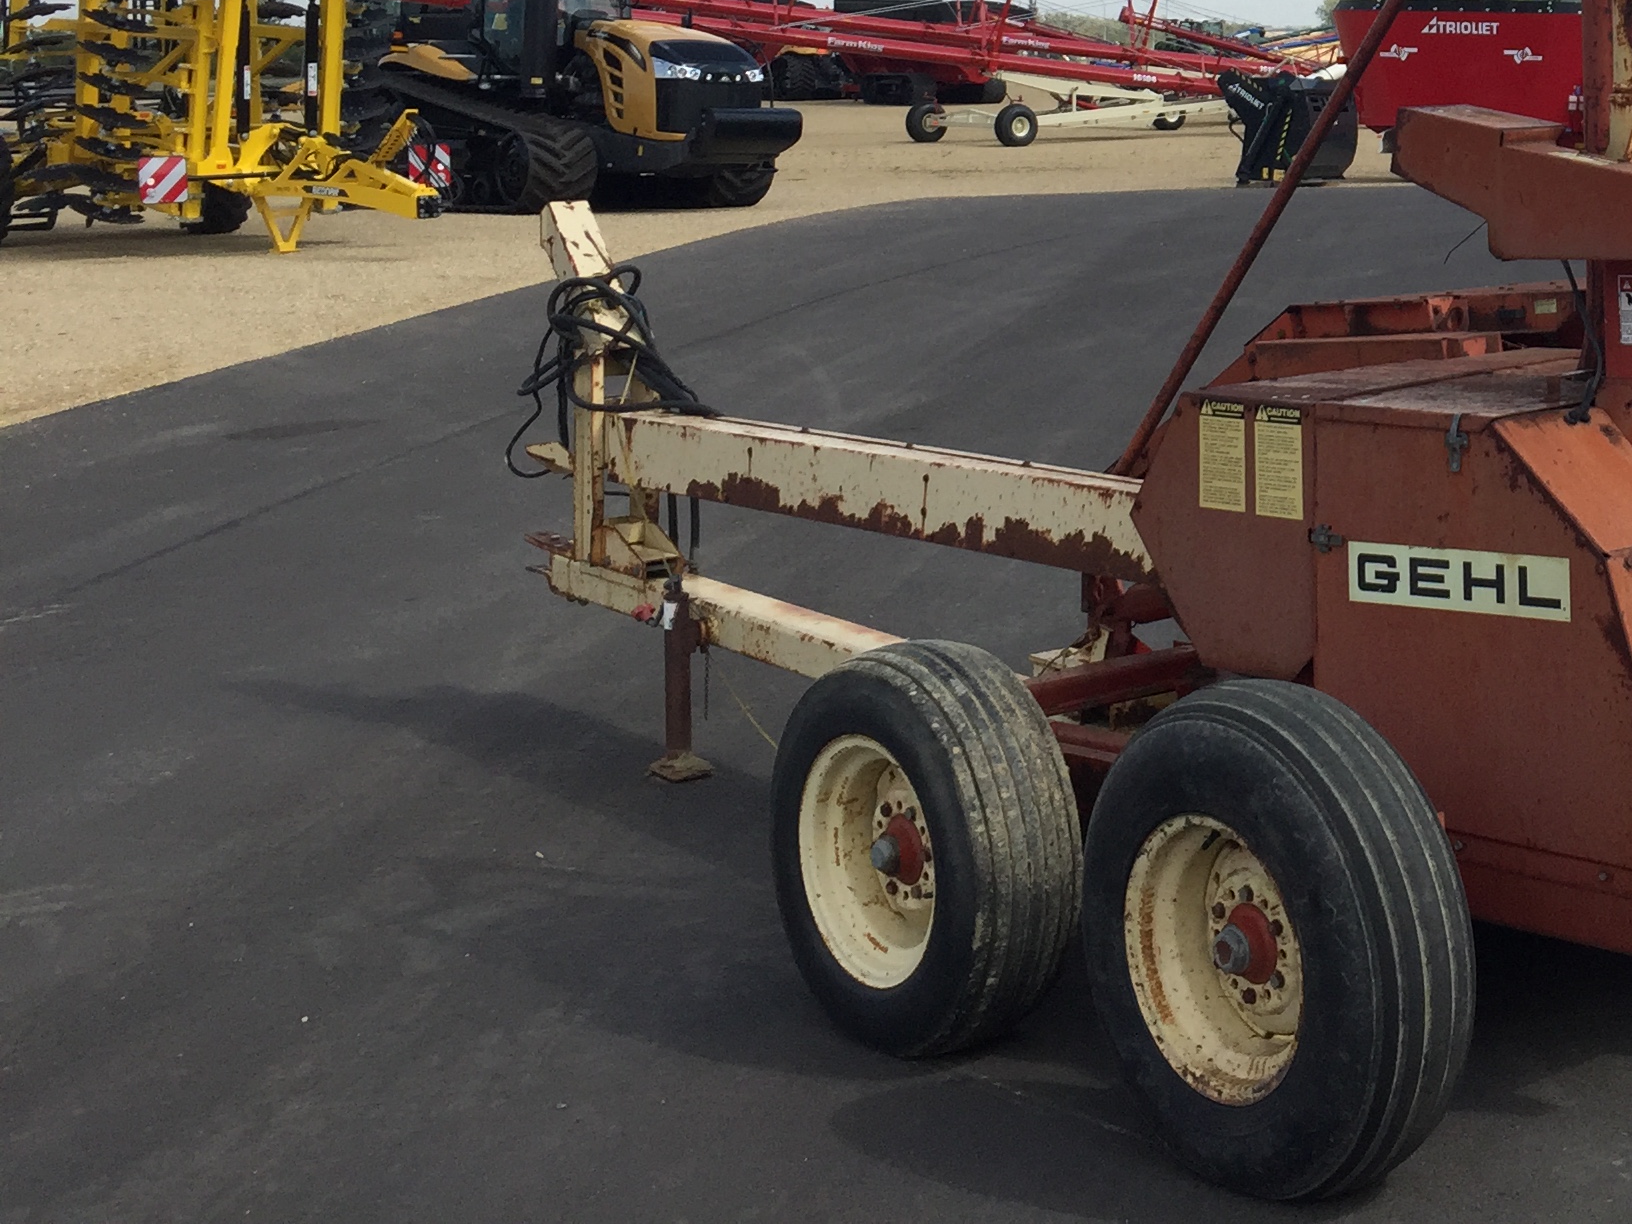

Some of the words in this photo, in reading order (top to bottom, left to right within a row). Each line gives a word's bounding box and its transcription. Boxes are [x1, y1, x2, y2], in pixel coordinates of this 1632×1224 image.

[1437, 21, 1500, 35] TRIOLIET
[1233, 83, 1265, 111] TRIOLIET
[1211, 401, 1245, 412] CAUTION
[1266, 407, 1300, 418] CAUTION
[1357, 552, 1562, 610] GEHL
